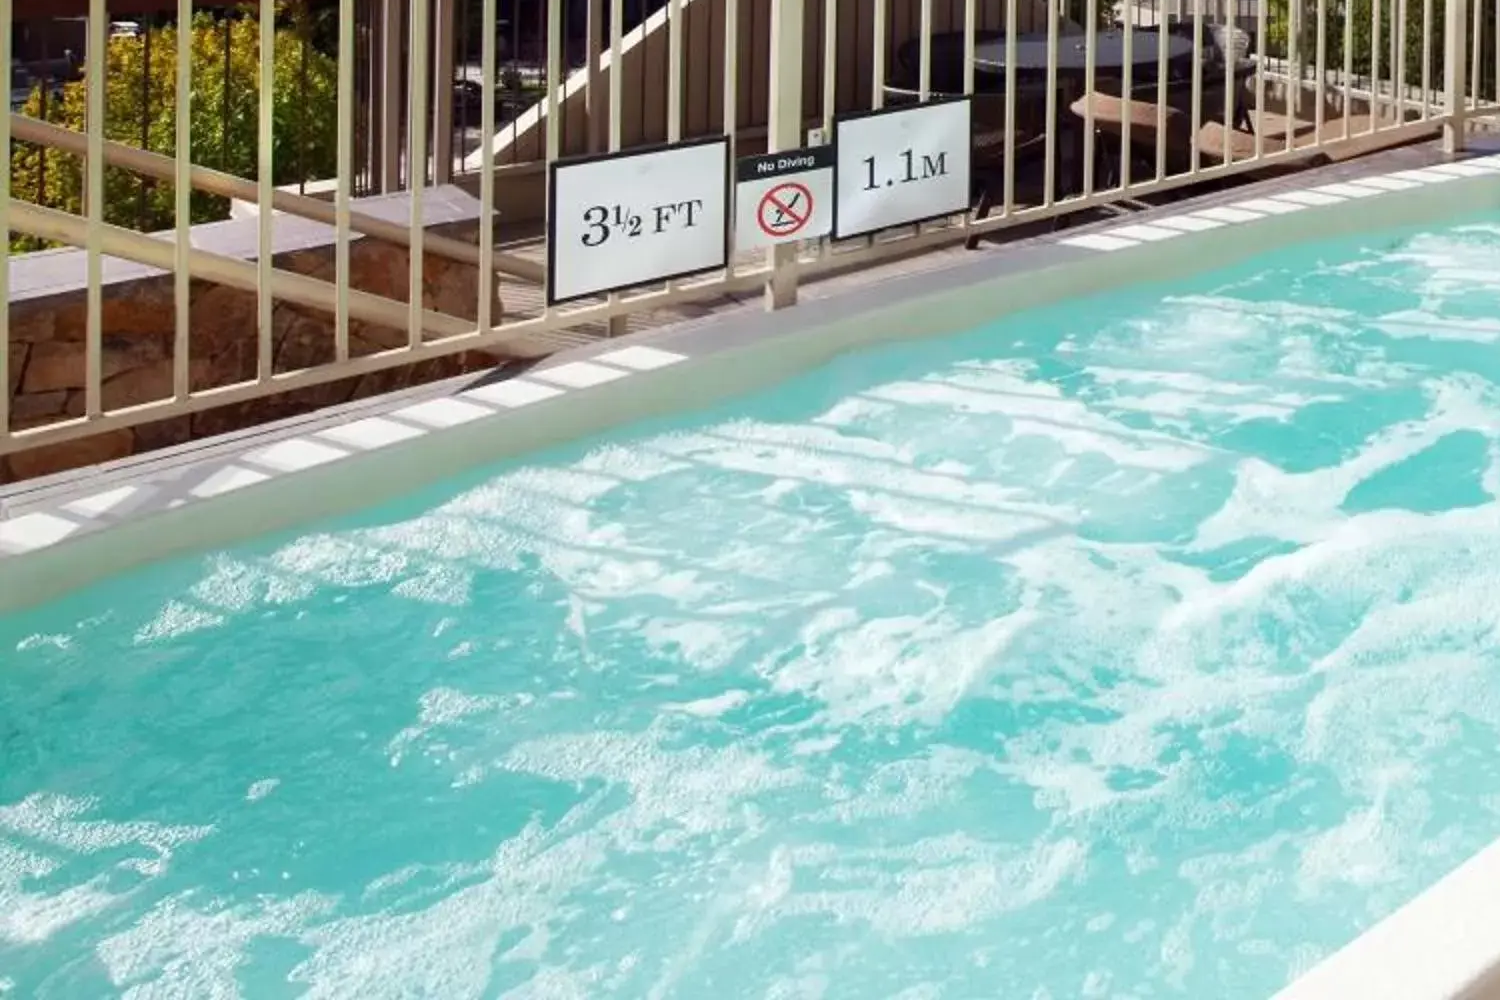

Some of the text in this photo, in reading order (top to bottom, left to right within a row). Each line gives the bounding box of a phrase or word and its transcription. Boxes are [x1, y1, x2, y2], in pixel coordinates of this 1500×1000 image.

[757, 155, 815, 173] No Diving
[652, 199, 703, 234] FT
